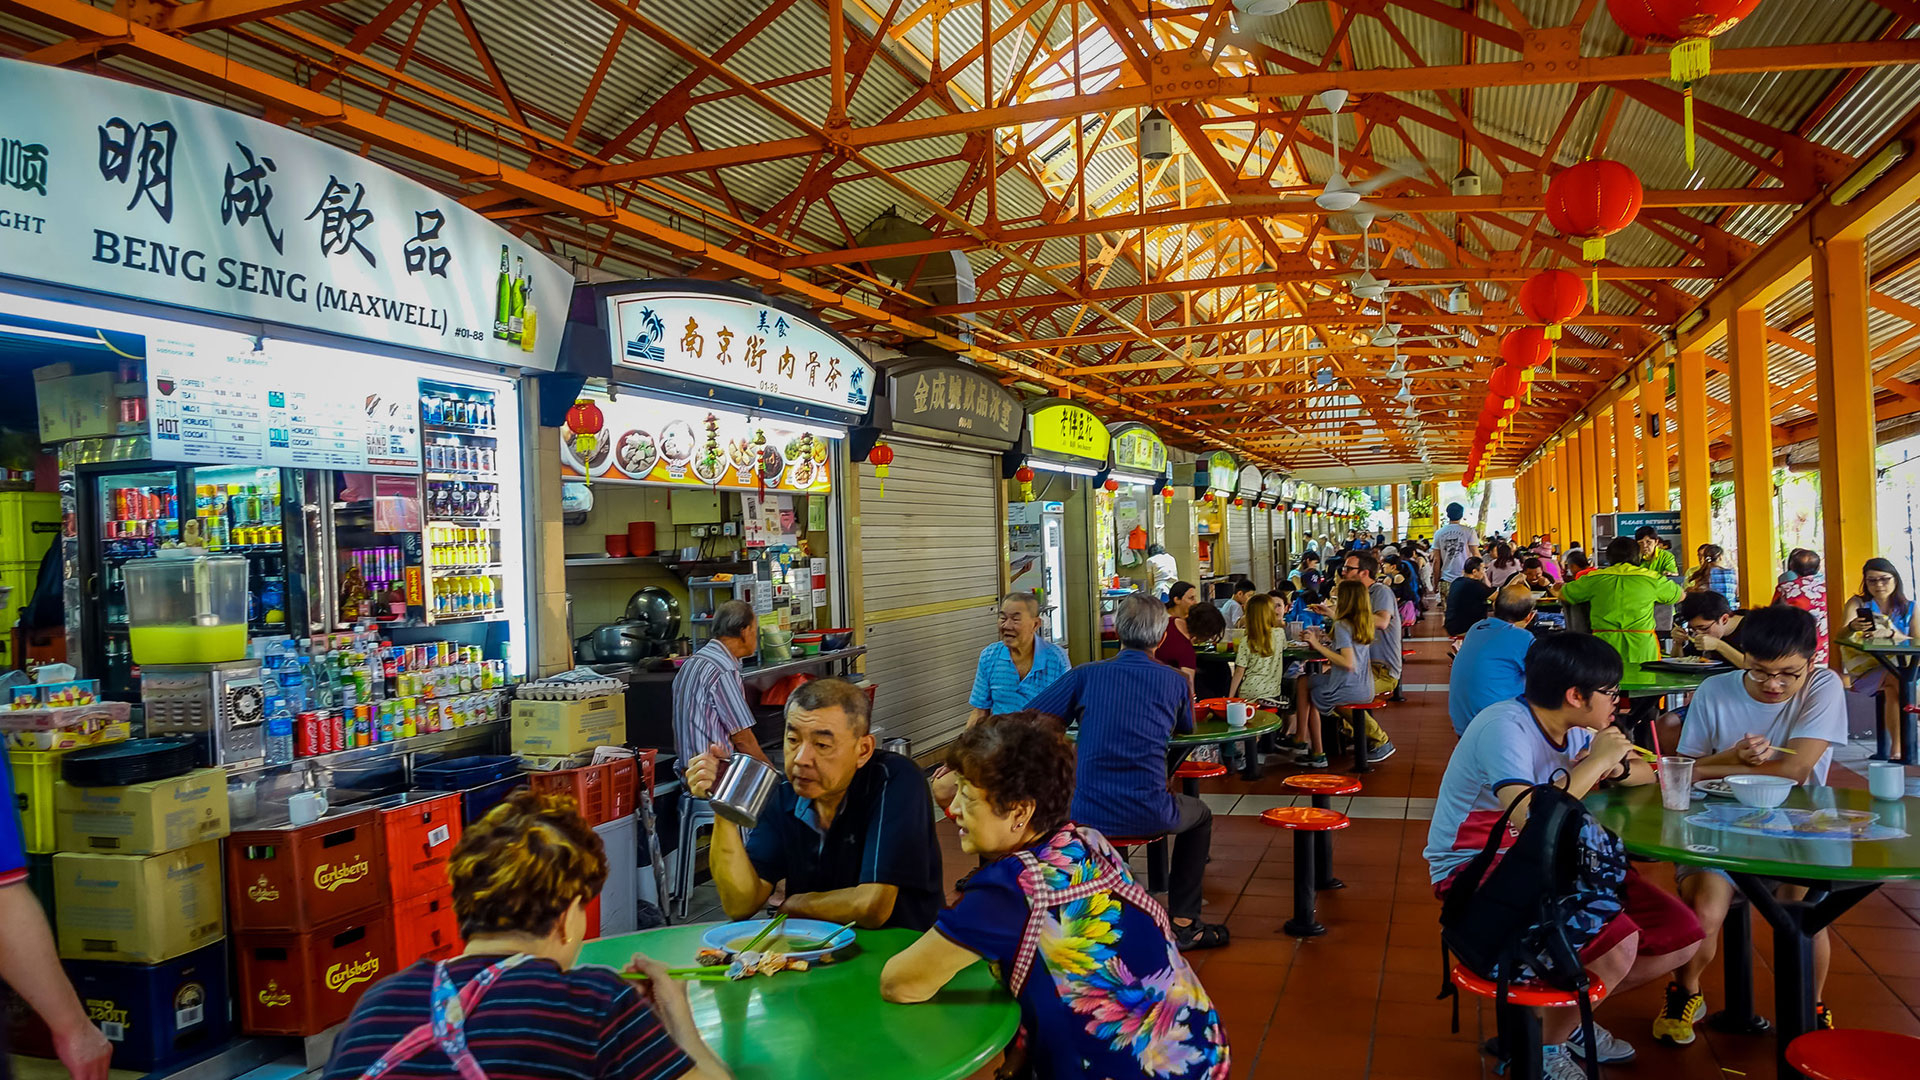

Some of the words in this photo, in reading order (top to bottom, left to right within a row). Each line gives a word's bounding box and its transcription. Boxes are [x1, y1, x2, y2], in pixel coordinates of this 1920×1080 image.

[98, 116, 453, 279] 明成飲品
[92, 229, 206, 283] BENG
[216, 257, 307, 304] SENG
[316, 281, 448, 336] (MAXWELL)
[454, 327, 484, 342] #01-88
[756, 310, 790, 338] 美食
[680, 316, 843, 393] 南京街肉骨茶
[759, 380, 778, 393] 01-89
[156, 418, 179, 433] HOT
[366, 436, 387, 446] SAND
[314, 856, 368, 891] Carlsberg
[326, 953, 379, 991] Carlsberg
